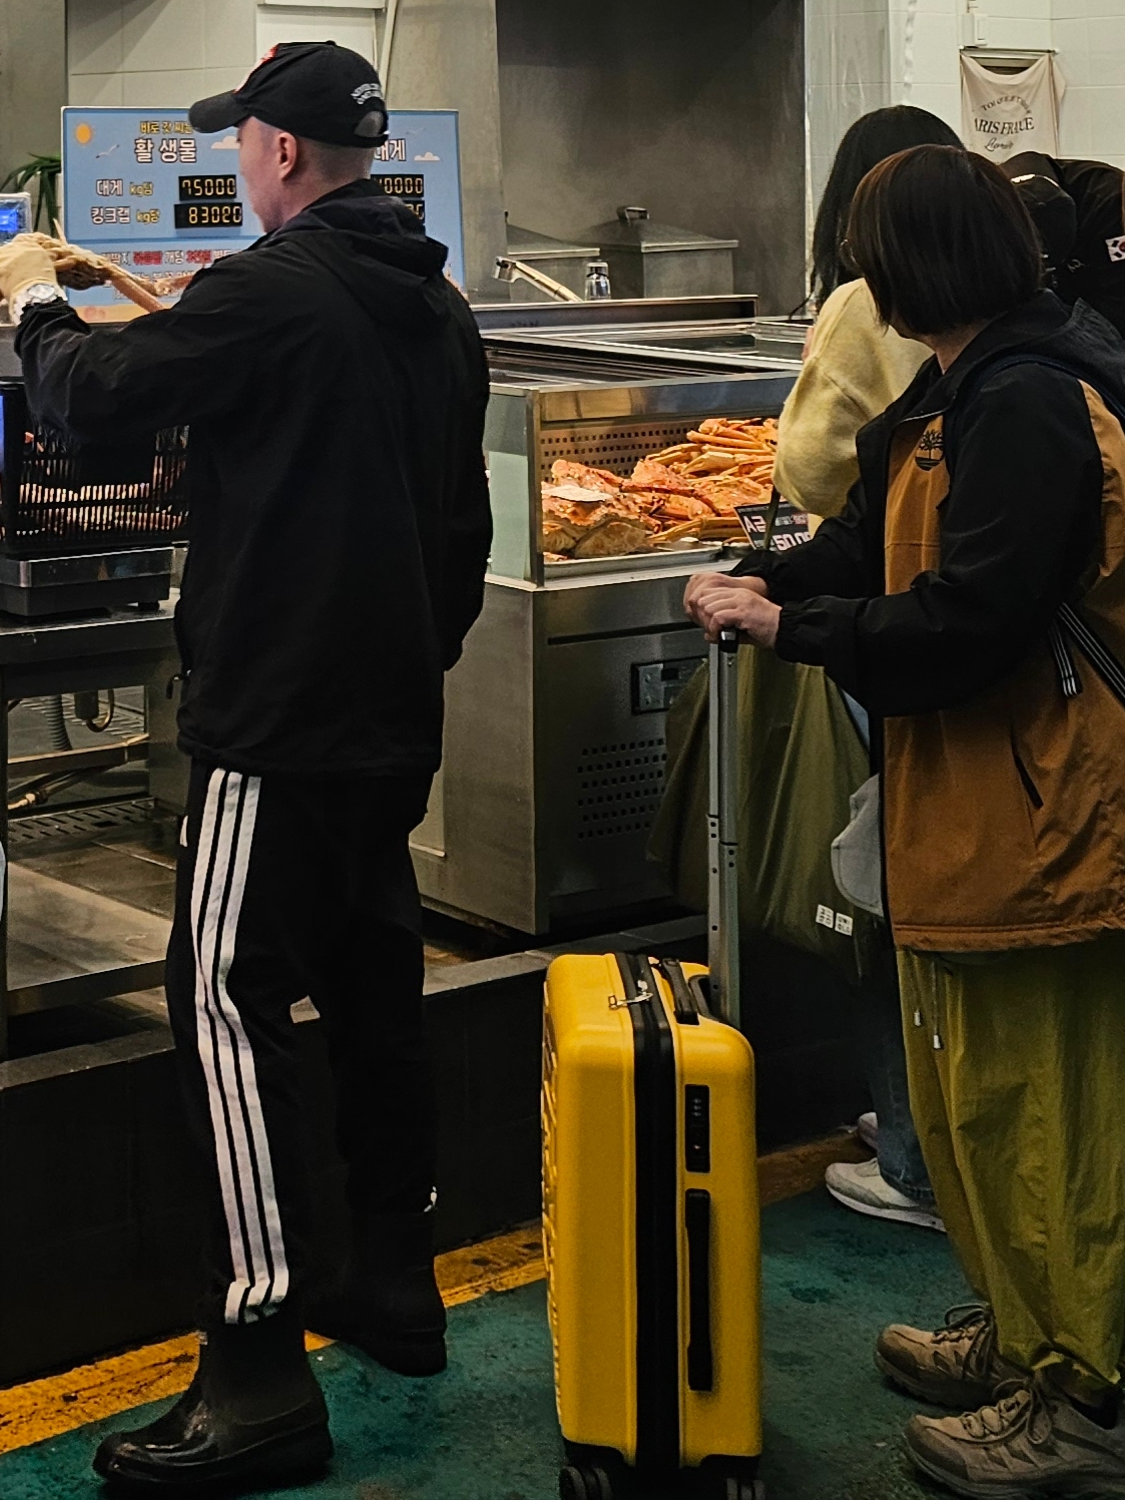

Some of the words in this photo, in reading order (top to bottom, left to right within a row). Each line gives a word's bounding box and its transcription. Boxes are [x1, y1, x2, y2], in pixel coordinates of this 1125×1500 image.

[134, 137, 154, 163] 활
[159, 137, 197, 163] 생물
[96, 178, 123, 197] 대게
[129, 181, 154, 197] kg당
[181, 178, 236, 196] 75000
[379, 177, 423, 194] 0000
[91, 205, 131, 225] 킹크랩
[135, 208, 161, 225] kg당
